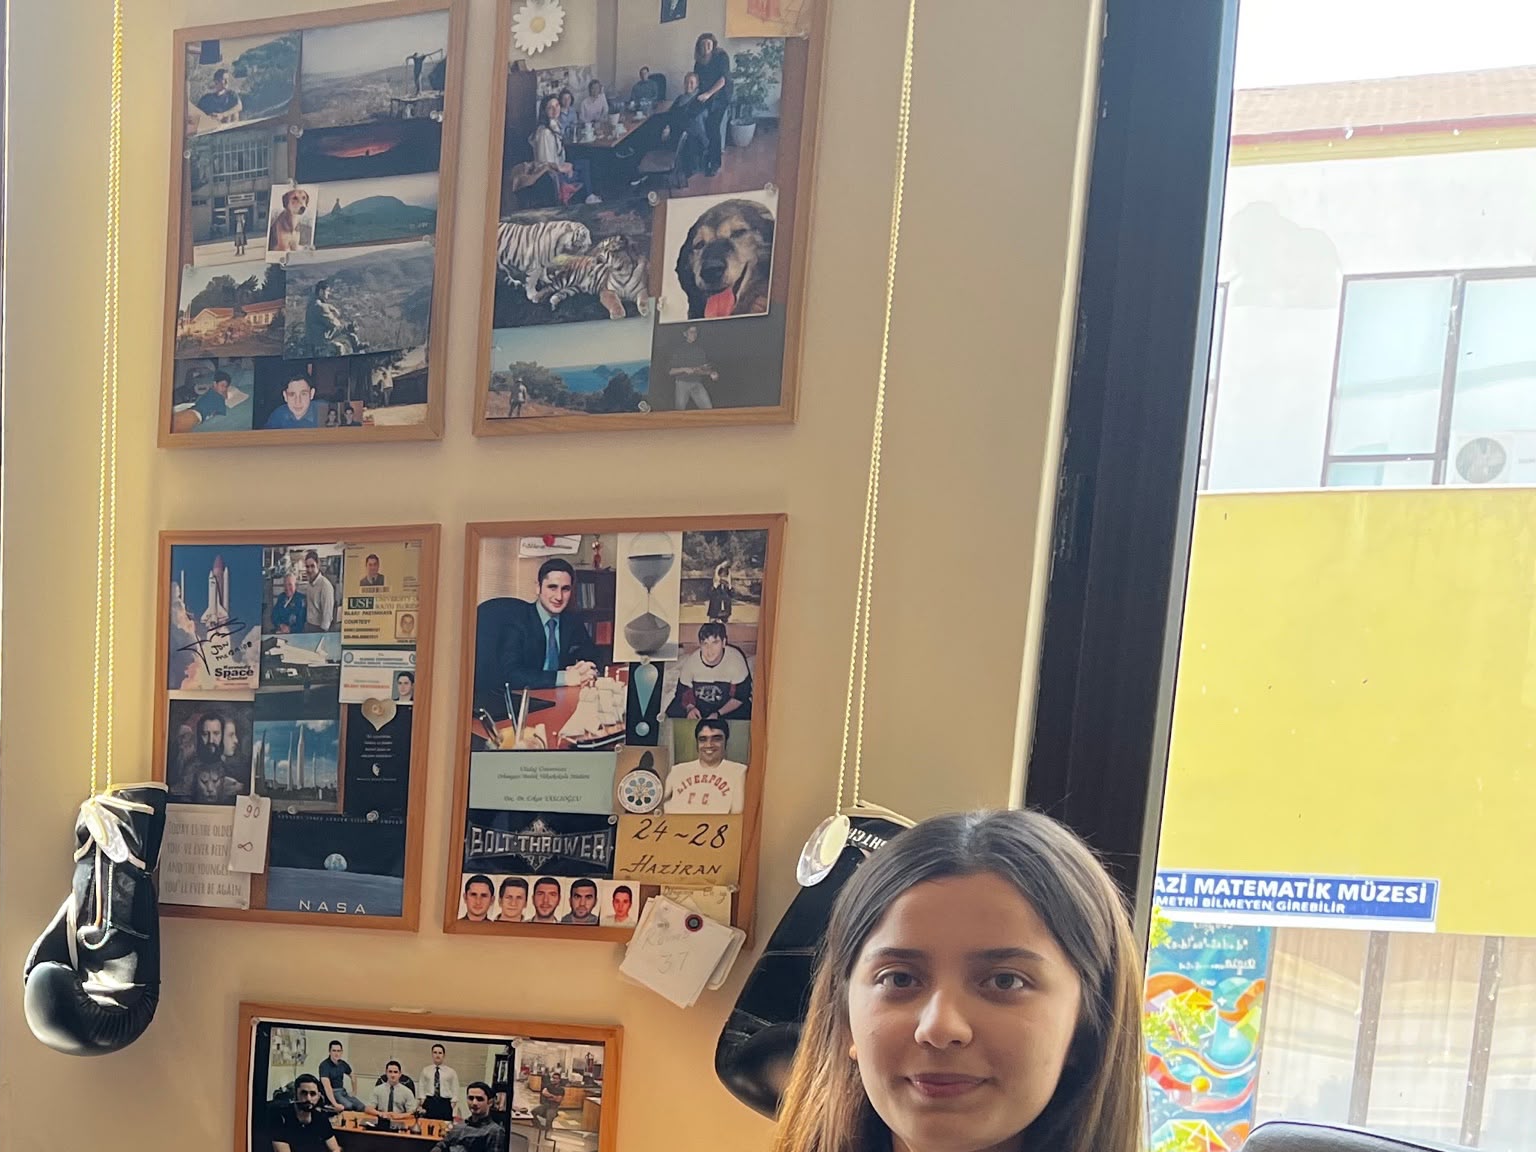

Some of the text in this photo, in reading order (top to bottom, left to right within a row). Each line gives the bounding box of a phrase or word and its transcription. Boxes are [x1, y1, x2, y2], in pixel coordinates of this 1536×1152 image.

[349, 597, 373, 609] USF
[214, 667, 255, 679] Space
[677, 774, 731, 797] LIVERPOOL
[470, 826, 606, 860] BOLT THROWER
[1194, 877, 1332, 900] MATEMATİK
[1338, 880, 1427, 904] MÜZESİ
[299, 899, 366, 915] NASA
[1153, 895, 1198, 907] METRİ
[1276, 900, 1346, 914] GİREBİLİR
